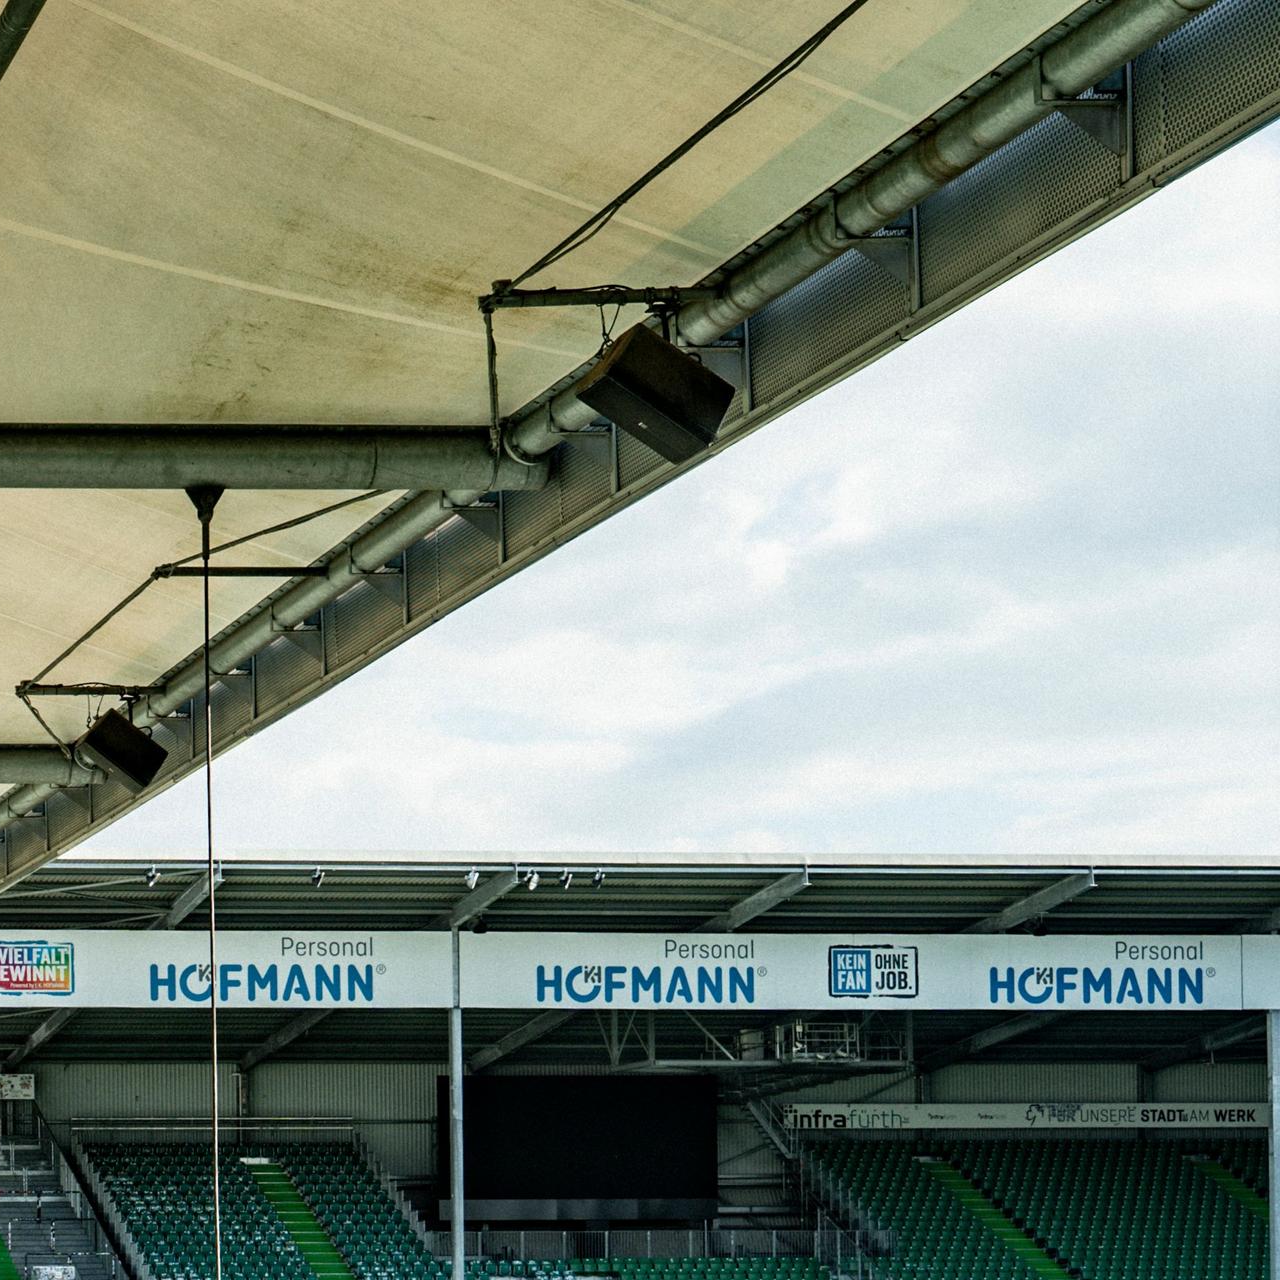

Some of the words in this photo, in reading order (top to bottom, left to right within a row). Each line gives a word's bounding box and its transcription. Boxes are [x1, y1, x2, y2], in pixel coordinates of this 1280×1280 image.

[281, 936, 373, 957] Personal
[664, 939, 755, 959] Personal
[1114, 940, 1203, 960] Personal
[837, 953, 867, 969] KEIN
[875, 953, 909, 969] OHNE
[536, 964, 755, 1004] HOFMANN
[837, 970, 867, 990] FAN
[875, 971, 912, 990] JOB.
[989, 966, 1204, 1004] HOFMANN
[1141, 1109, 1184, 1122] STADT
[1189, 1110, 1210, 1122] AM
[1214, 1109, 1256, 1122] WERK
